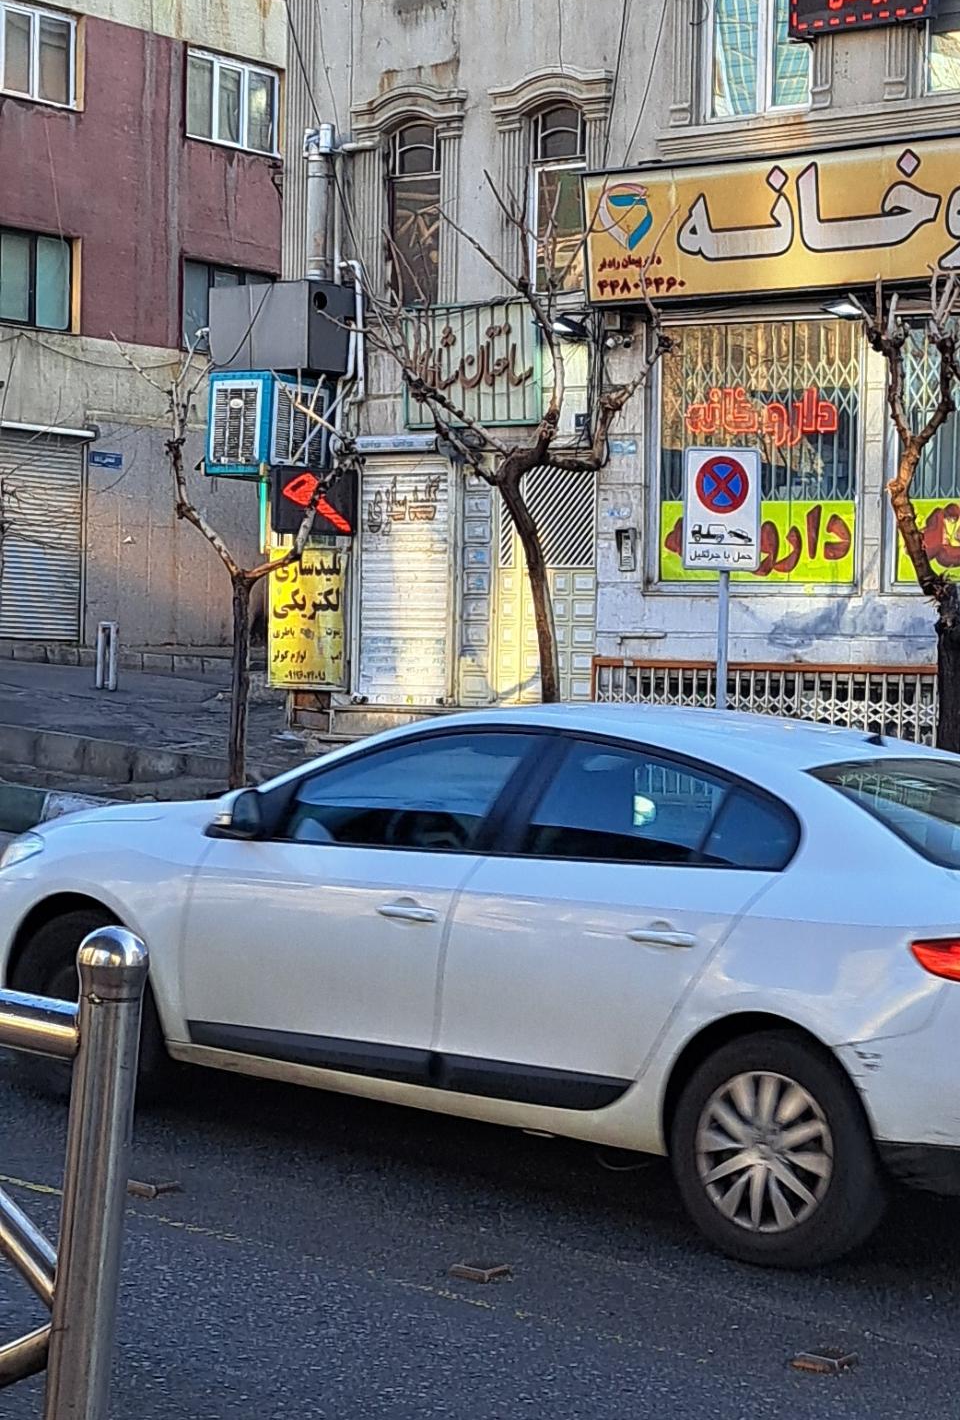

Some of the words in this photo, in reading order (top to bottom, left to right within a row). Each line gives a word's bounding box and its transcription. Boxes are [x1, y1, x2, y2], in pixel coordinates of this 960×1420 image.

[459, 323, 534, 388] ساختمان
[684, 386, 838, 446] داروخانه
[690, 549, 720, 561] جرثقیل
[723, 550, 731, 562] با
[733, 551, 752, 563] حمل
[273, 588, 340, 620] لکتریکی
